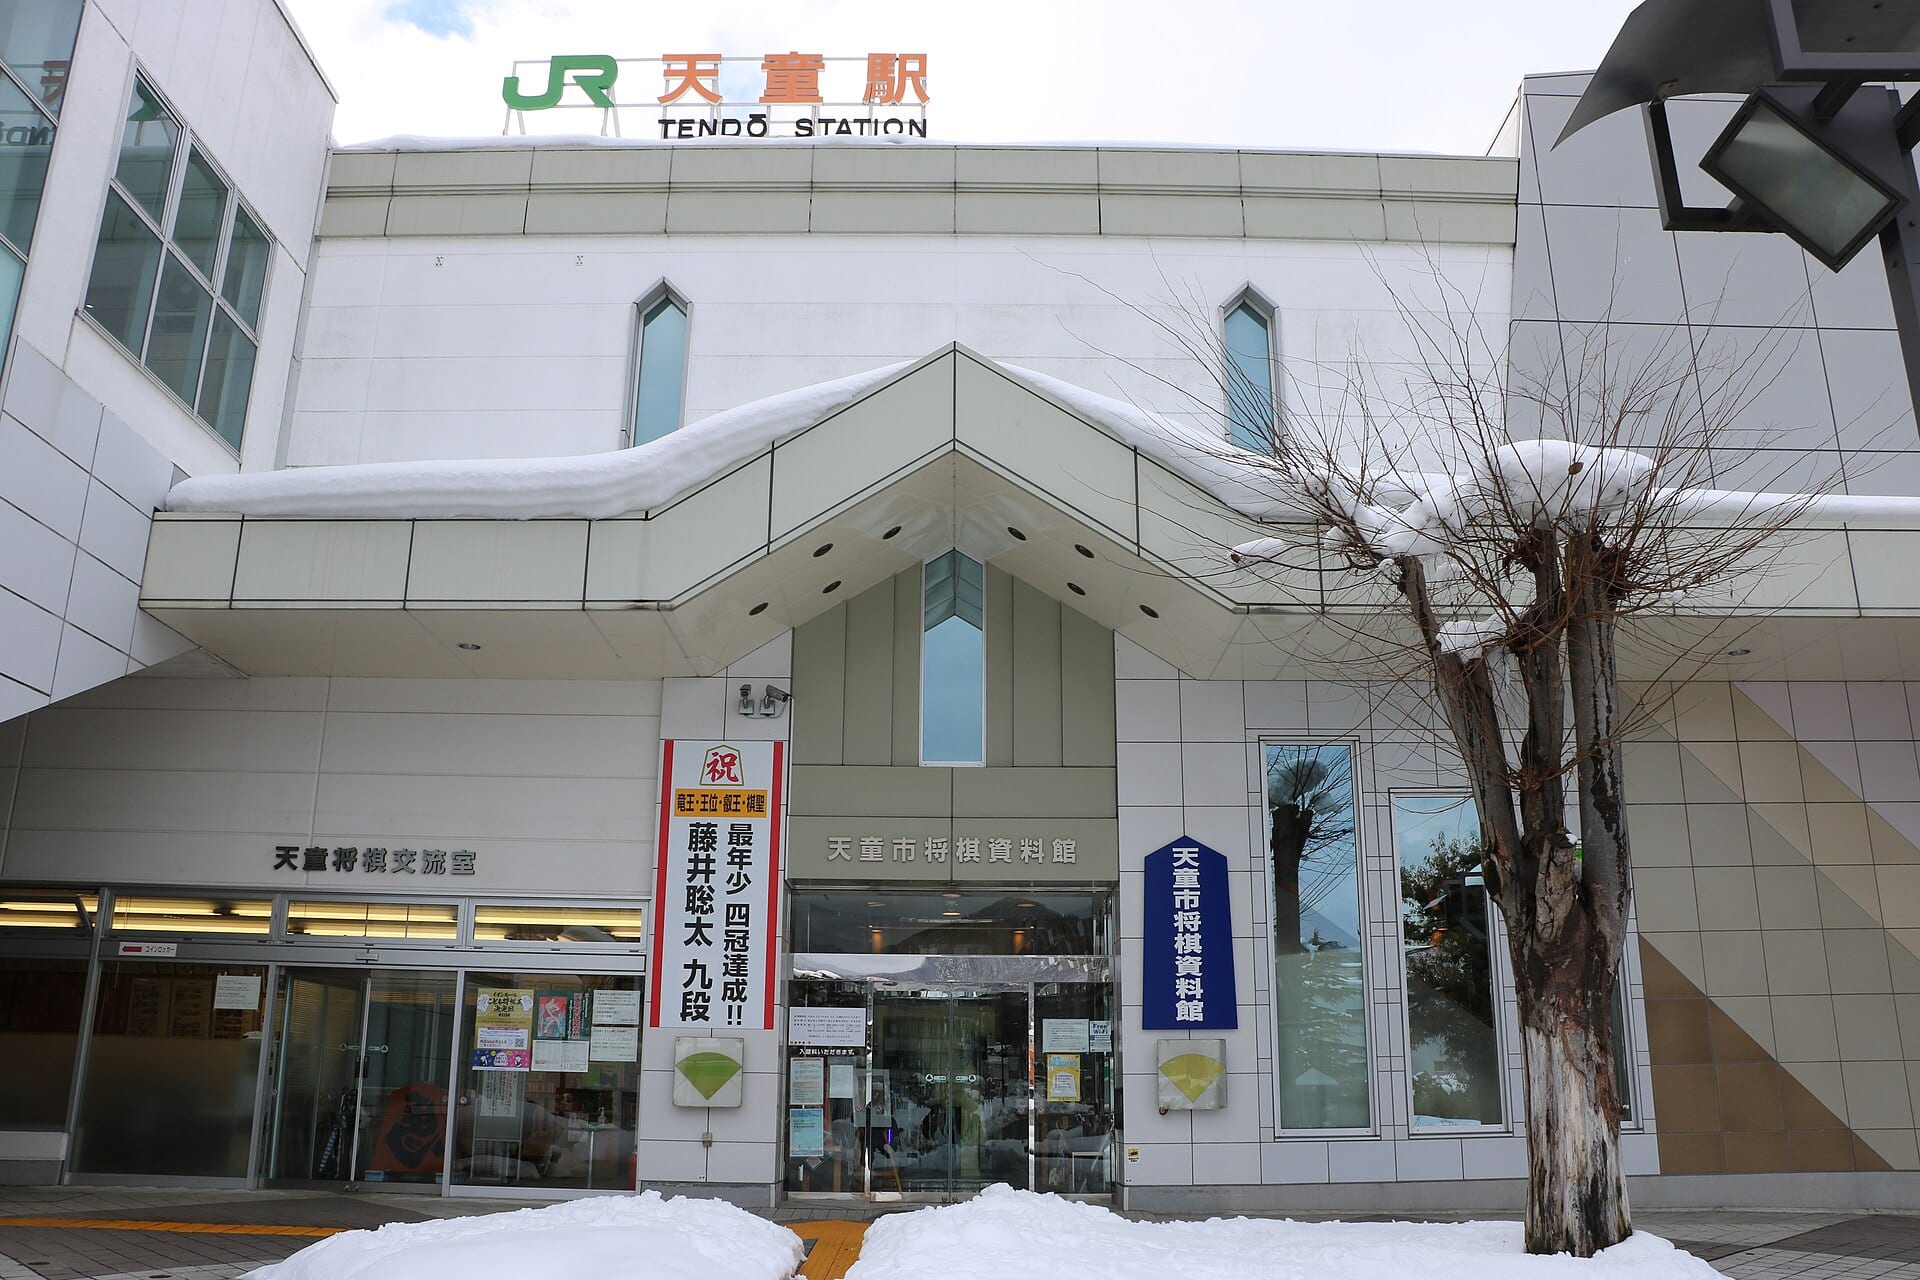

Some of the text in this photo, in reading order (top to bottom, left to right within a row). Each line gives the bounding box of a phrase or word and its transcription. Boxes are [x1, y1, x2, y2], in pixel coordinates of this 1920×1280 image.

[502, 54, 619, 111] JR
[657, 51, 930, 106] 天童駅
[795, 118, 927, 138] STATION
[706, 751, 739, 783] 祝
[273, 845, 476, 875] 天童将棋交流室
[725, 823, 754, 895] 最年少
[827, 836, 1077, 864] 天童市将棋資料館
[680, 822, 718, 1022] 藤井聡太 九段
[1172, 847, 1204, 1022] 天童市将棋資料館
